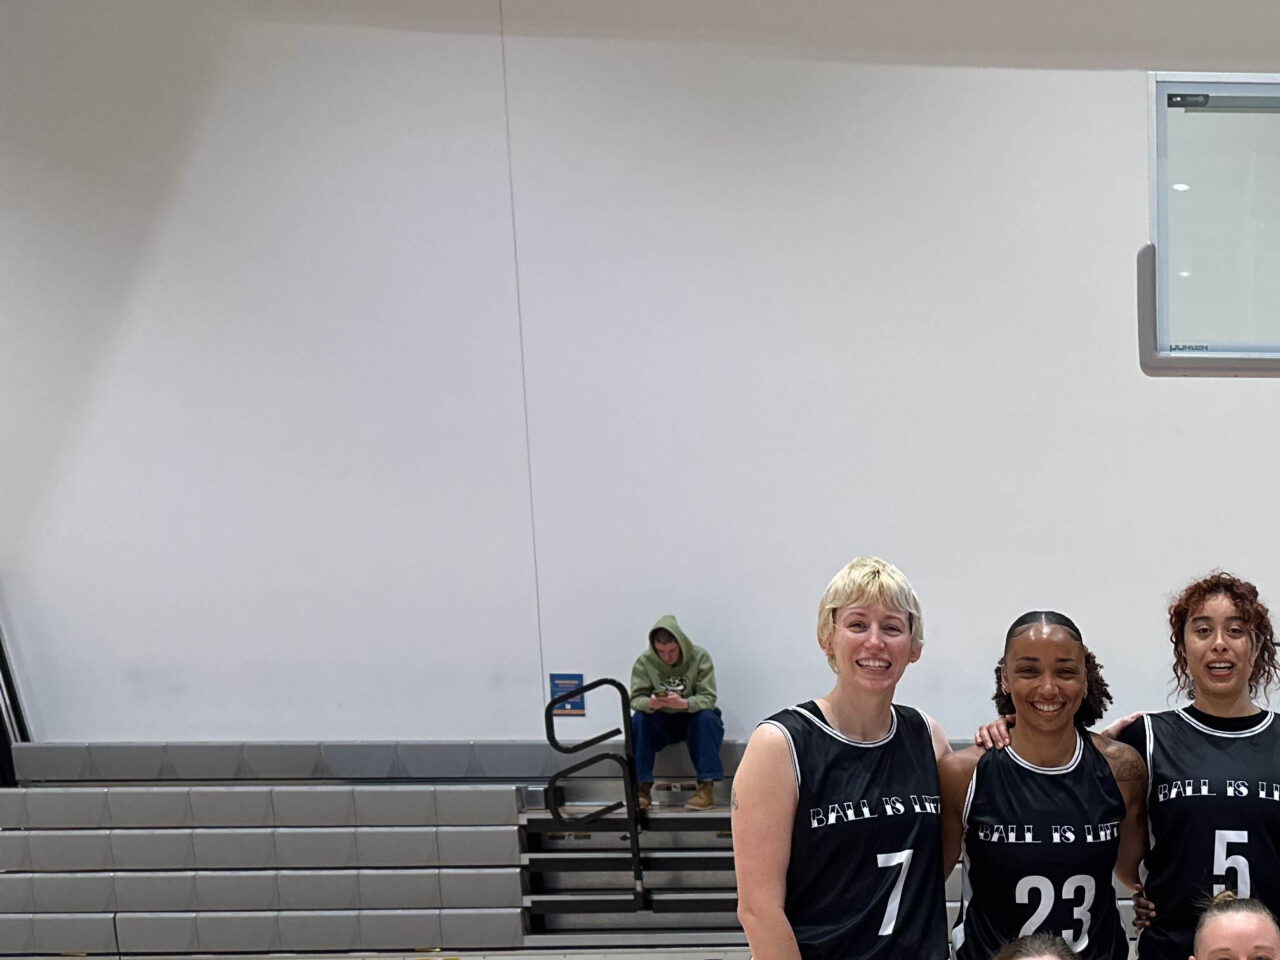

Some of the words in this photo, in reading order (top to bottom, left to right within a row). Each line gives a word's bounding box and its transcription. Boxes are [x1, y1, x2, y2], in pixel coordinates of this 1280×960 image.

[810, 799, 878, 829] BALL
[882, 796, 905, 816] IS
[909, 795, 941, 814] LIF
[1158, 779, 1217, 802] BALL
[1226, 780, 1249, 797] IS
[978, 824, 1042, 843] BALL
[1051, 825, 1076, 843] IS
[1212, 829, 1251, 899] 5
[876, 849, 914, 936] 7
[1015, 874, 1096, 953] 23
